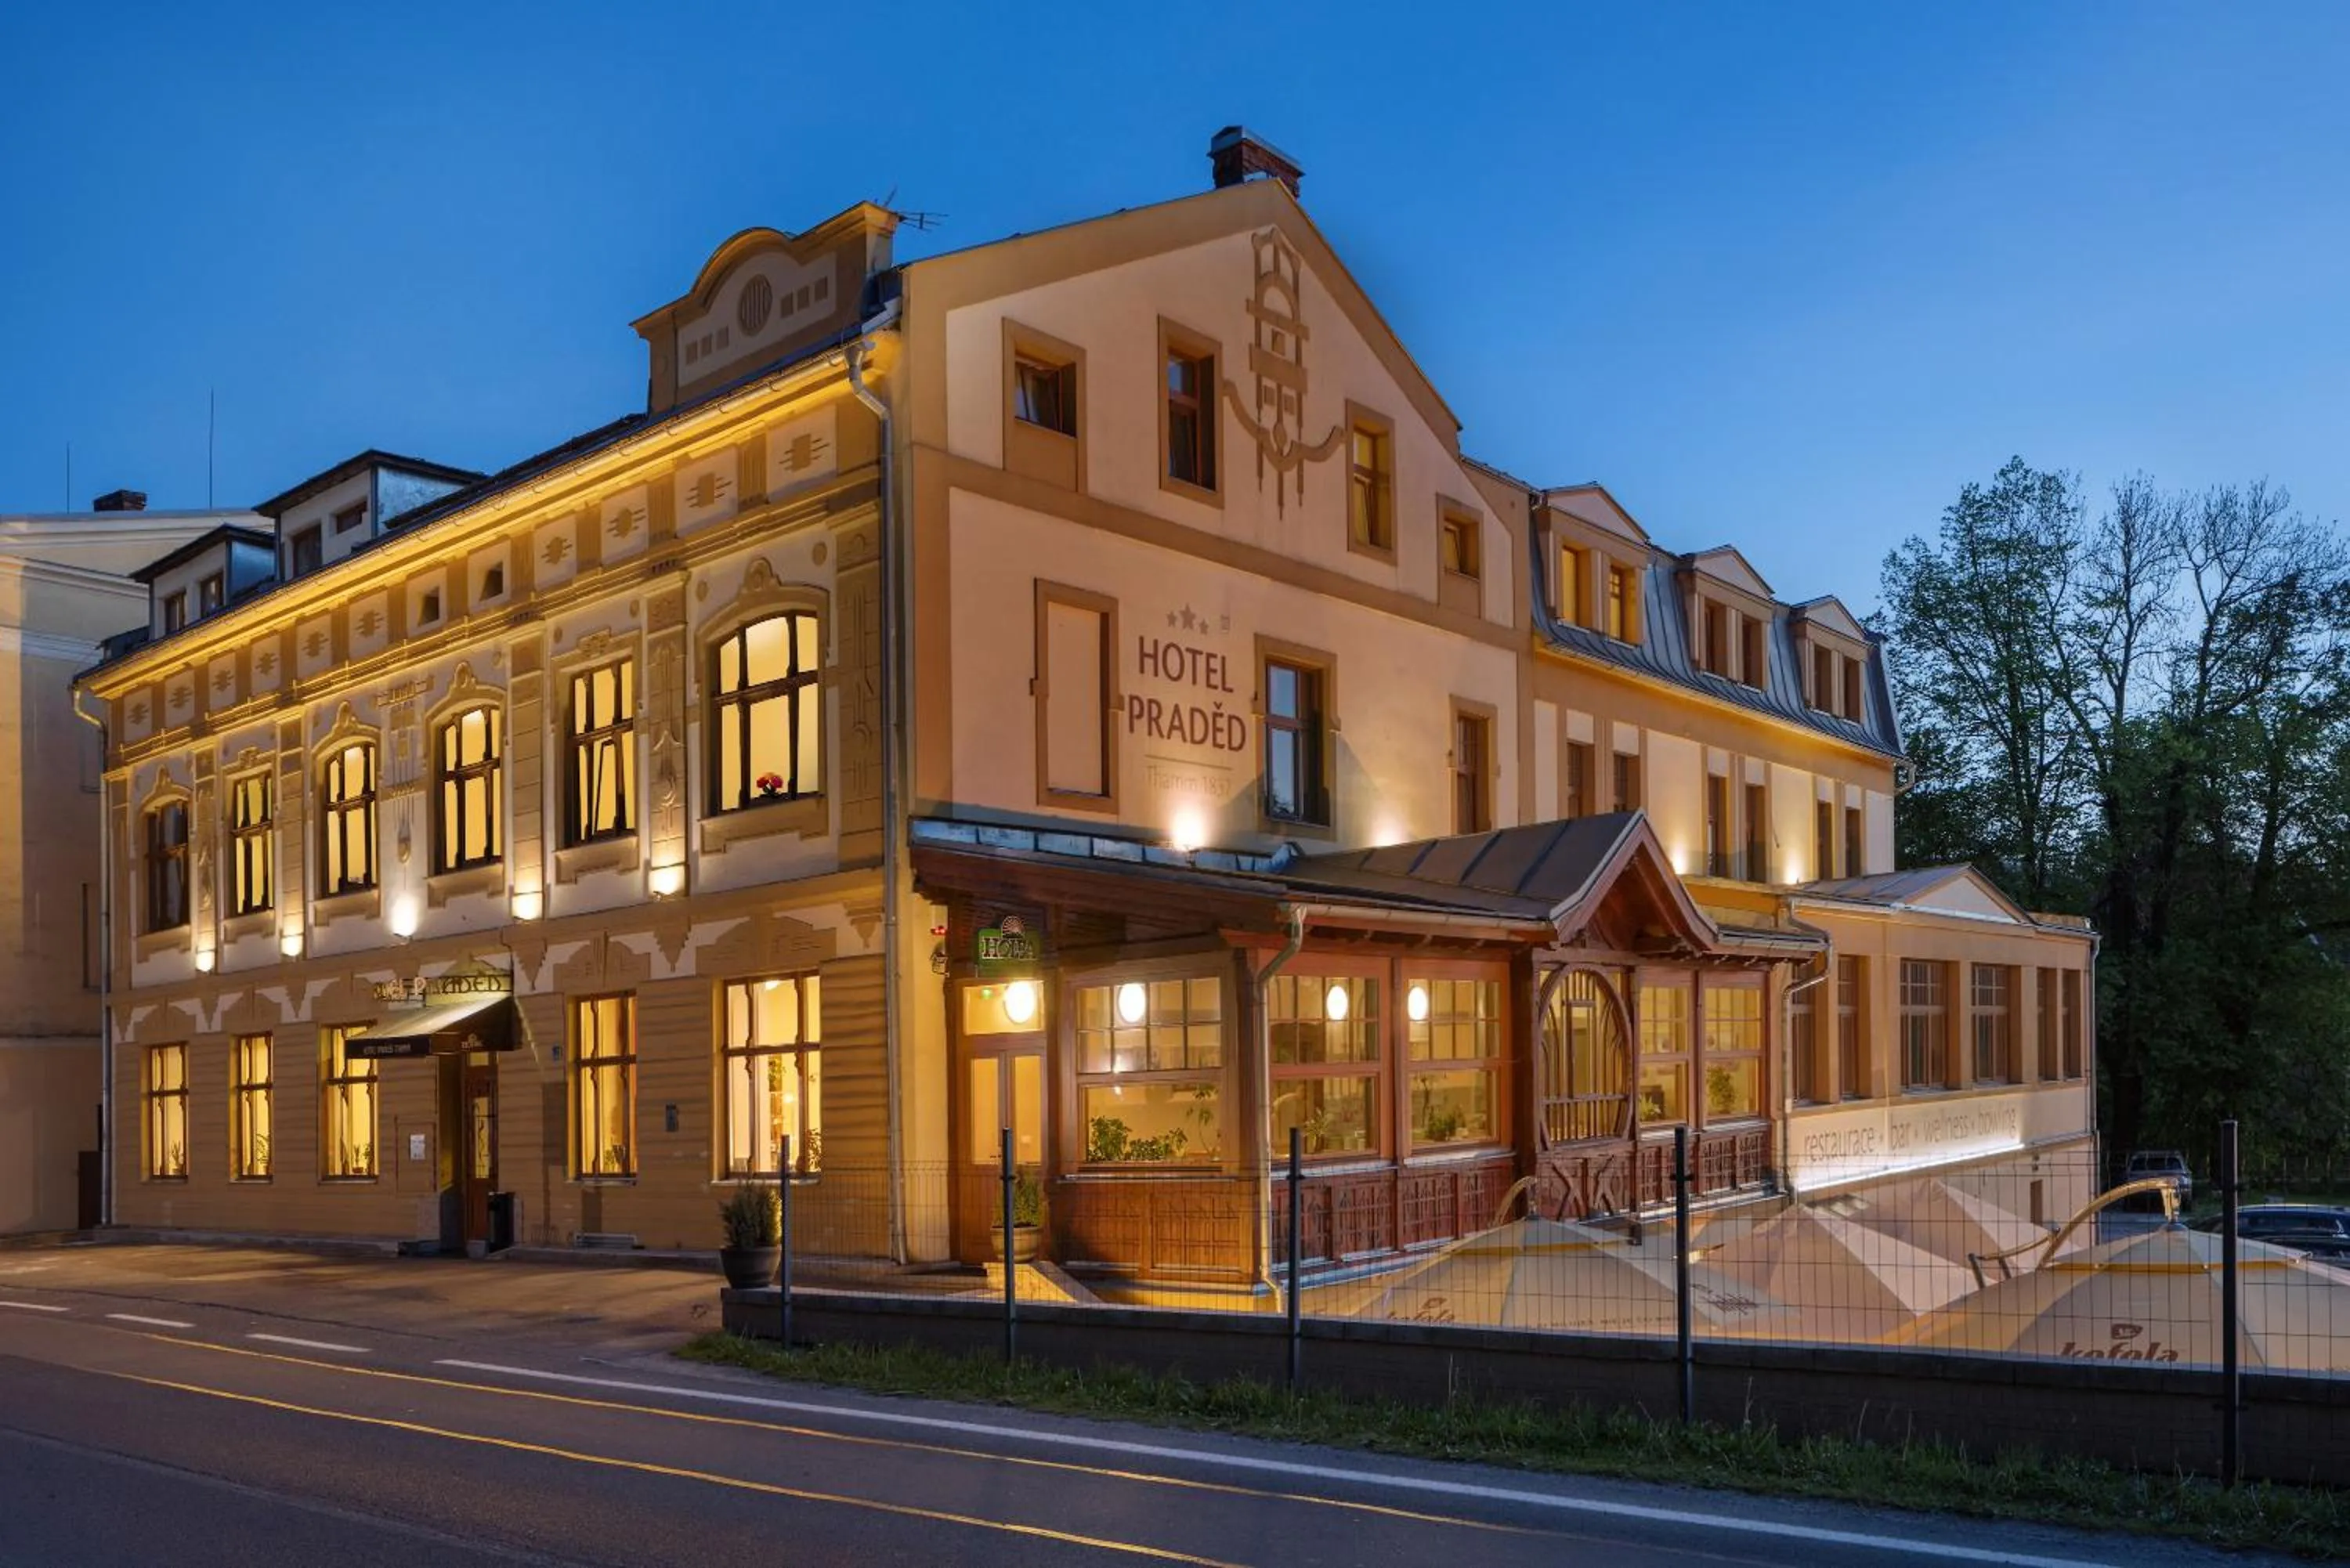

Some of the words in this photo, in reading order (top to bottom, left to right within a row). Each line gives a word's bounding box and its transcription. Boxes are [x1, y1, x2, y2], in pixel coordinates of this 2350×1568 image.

[1138, 634, 1235, 694] HOTEL
[1128, 694, 1247, 753] PRADĚD
[1803, 1126, 1875, 1163] restaurace
[1890, 1111, 1912, 1151] bar
